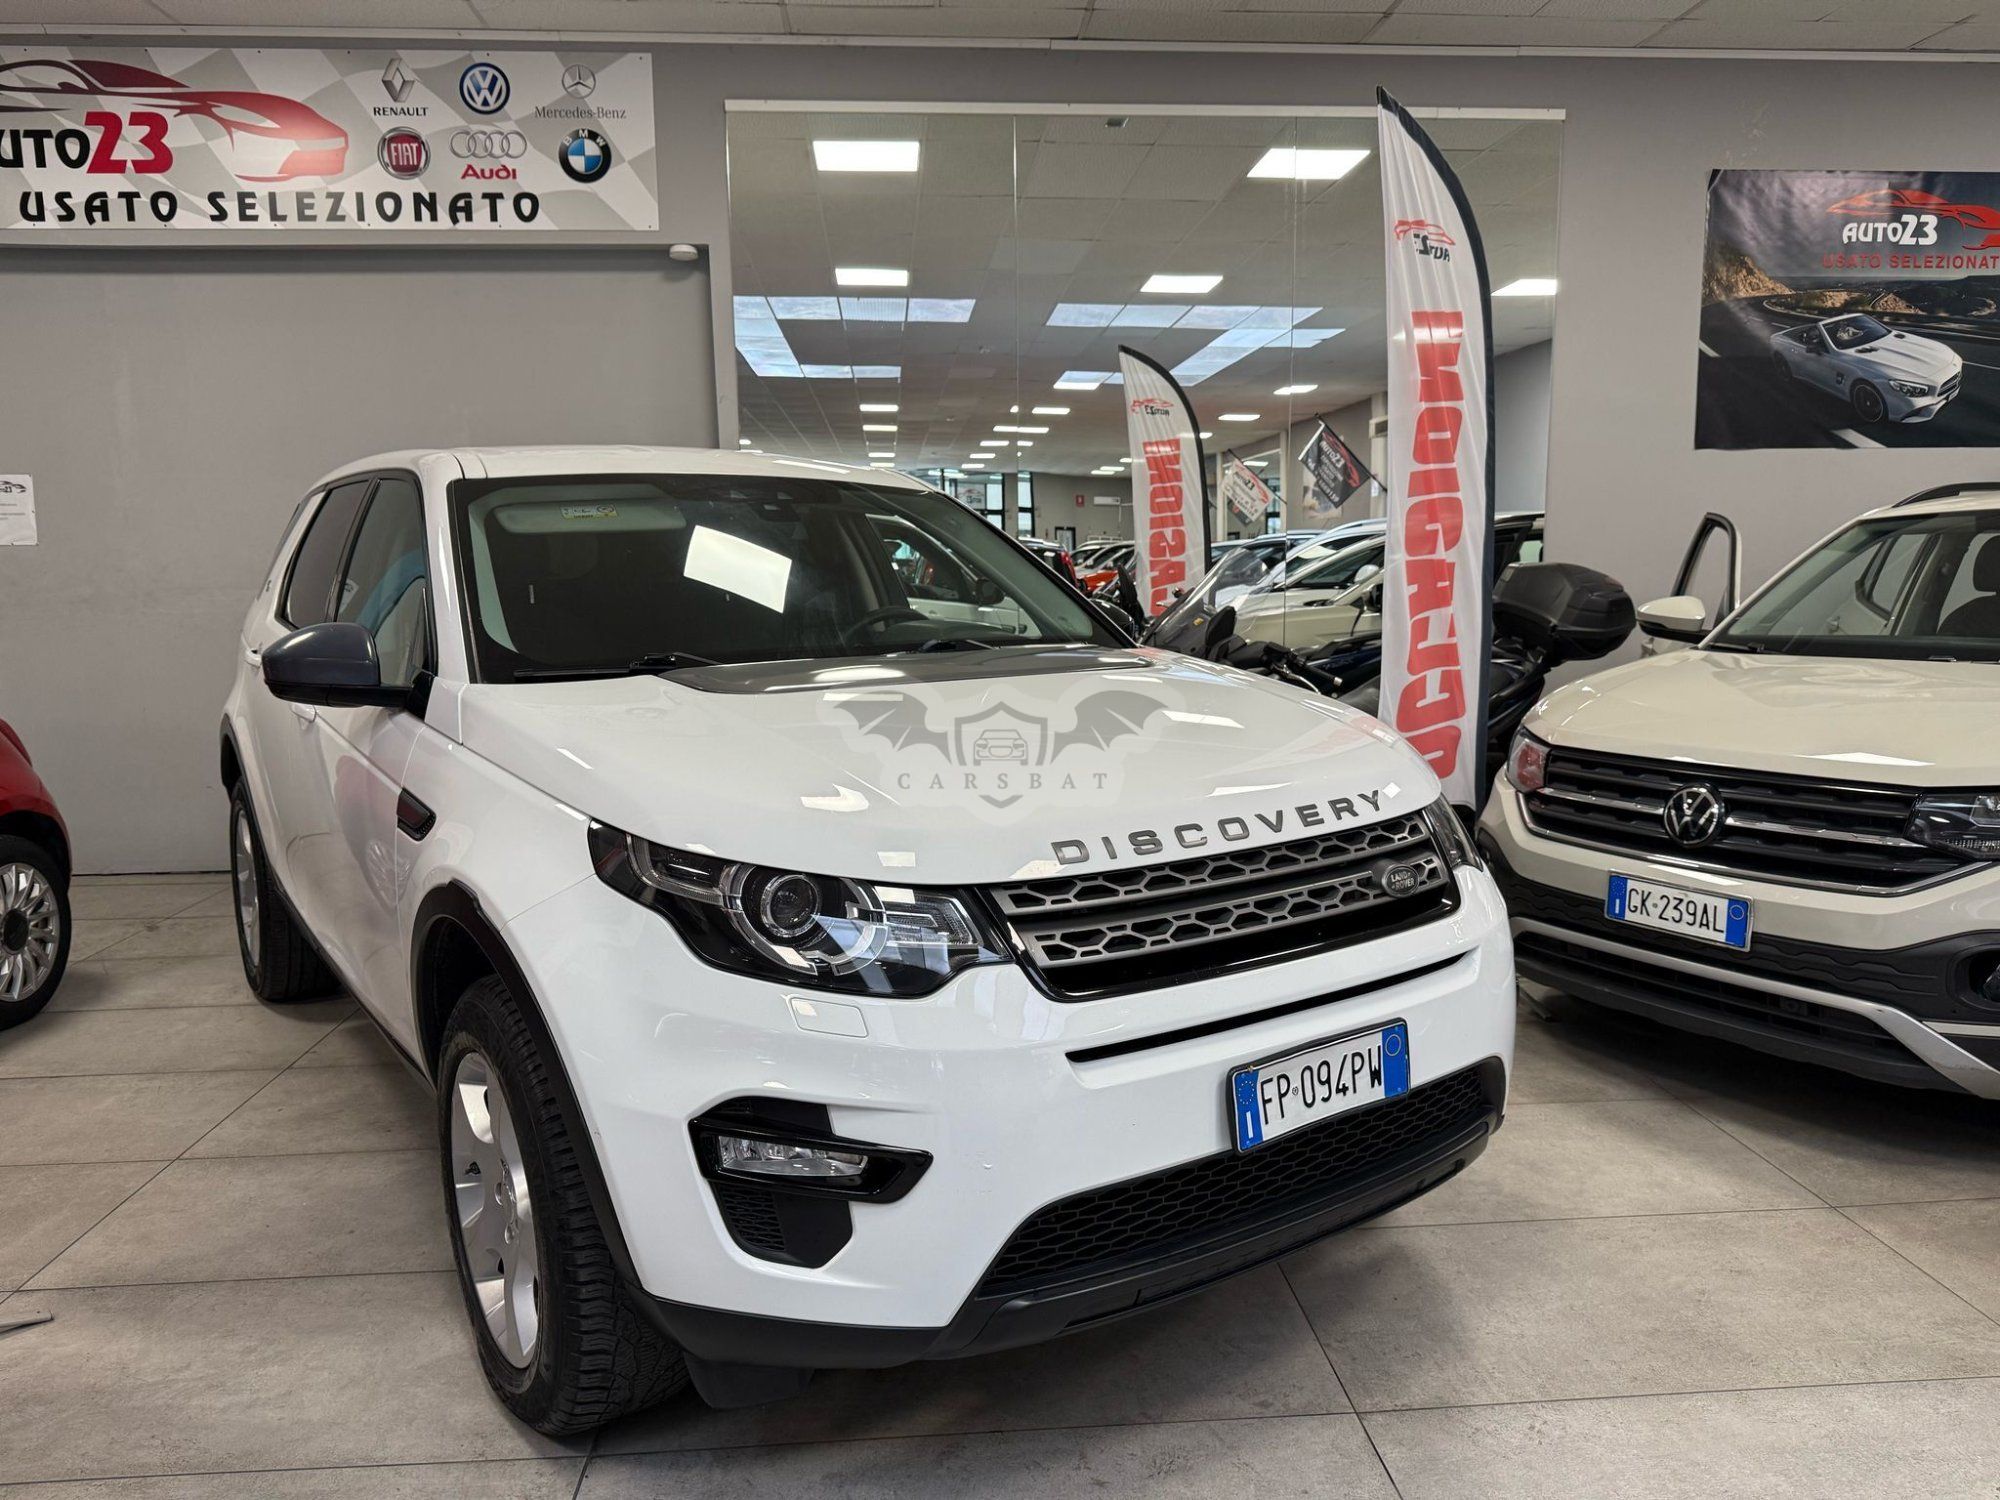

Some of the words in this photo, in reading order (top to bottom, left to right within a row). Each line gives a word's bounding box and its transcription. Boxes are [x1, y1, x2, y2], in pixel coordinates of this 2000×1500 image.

[373, 106, 428, 117] RENAULT
[534, 105, 627, 120] Mercedes-Benz
[0, 111, 174, 174] UTO23
[562, 128, 606, 148] BMW
[390, 142, 419, 166] FIAT
[460, 164, 517, 180] Audi
[19, 190, 178, 226] USATO
[207, 190, 540, 226] SELEZIONATO
[1842, 214, 1938, 245] AUTO23
[1822, 254, 1882, 270] USATO
[1888, 254, 2000, 270] SELEZIONAT
[1050, 789, 1381, 865] DISCOVERY
